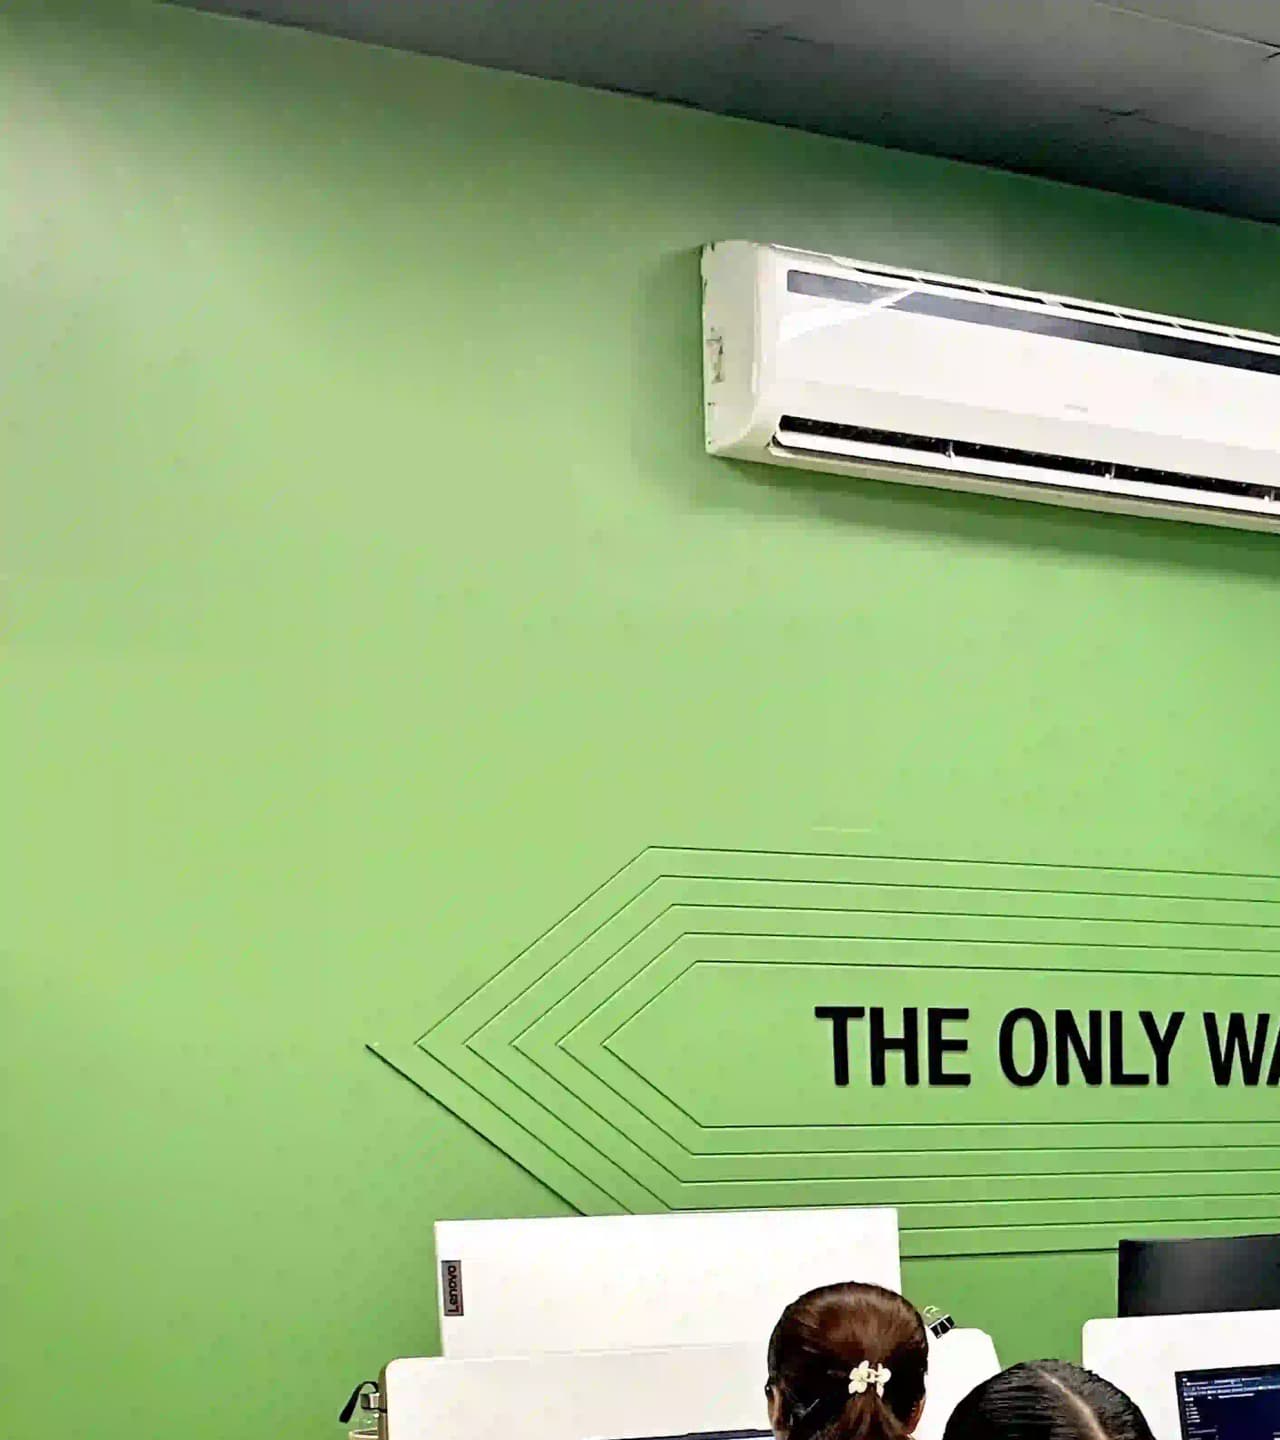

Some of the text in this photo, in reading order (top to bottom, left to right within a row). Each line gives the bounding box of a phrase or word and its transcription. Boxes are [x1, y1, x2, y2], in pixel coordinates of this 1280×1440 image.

[815, 1006, 970, 1087] THE
[999, 1007, 1185, 1087] ONLY
[447, 1265, 460, 1312] Lenovo
